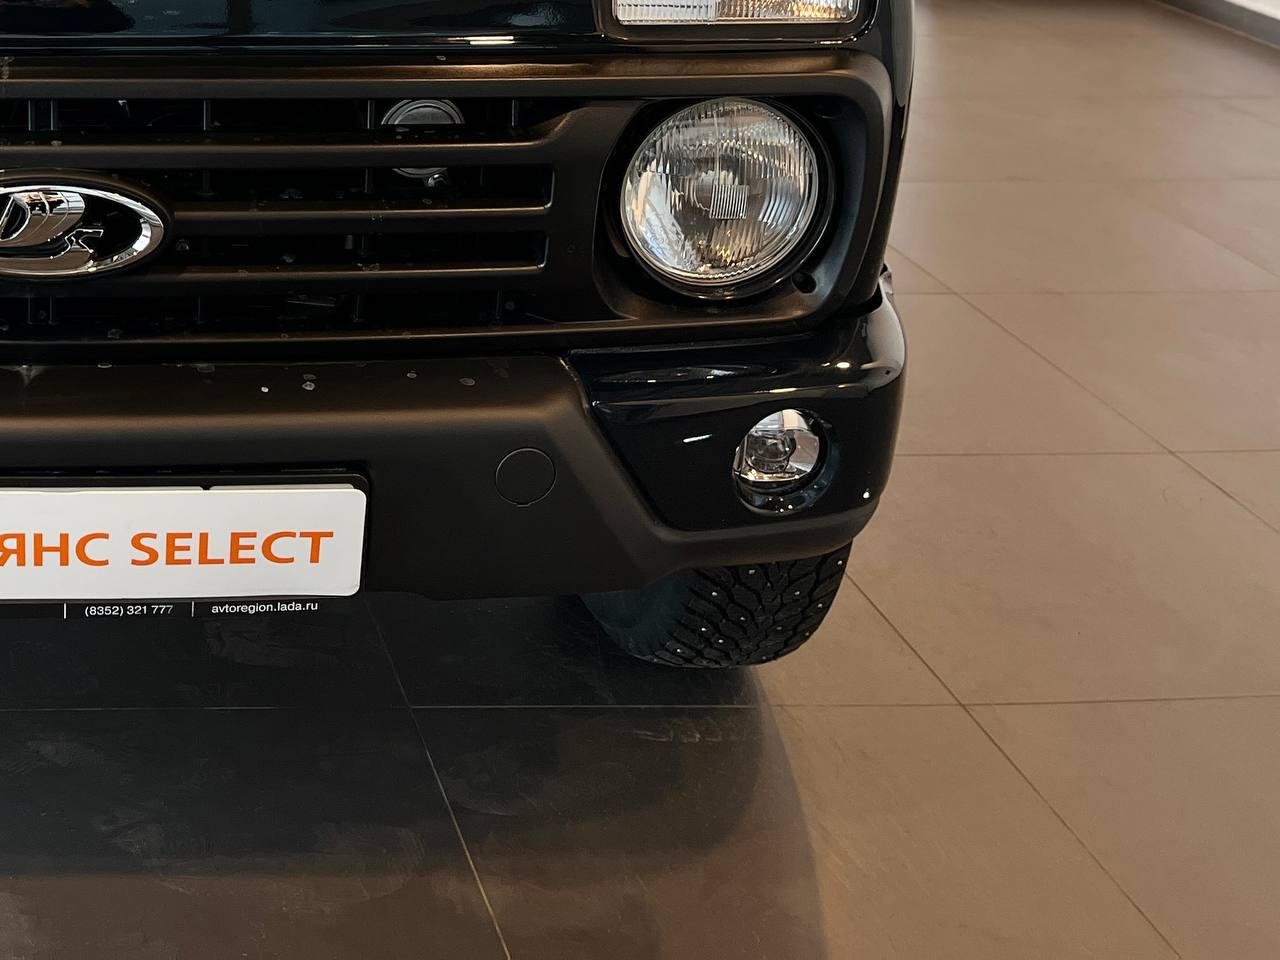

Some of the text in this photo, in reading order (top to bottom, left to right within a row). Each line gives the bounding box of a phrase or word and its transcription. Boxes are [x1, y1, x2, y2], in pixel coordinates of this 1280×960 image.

[130, 531, 334, 567] SELECT
[84, 604, 175, 618] (8352) 321 777
[210, 600, 320, 617] avtoregion.lada.ru
